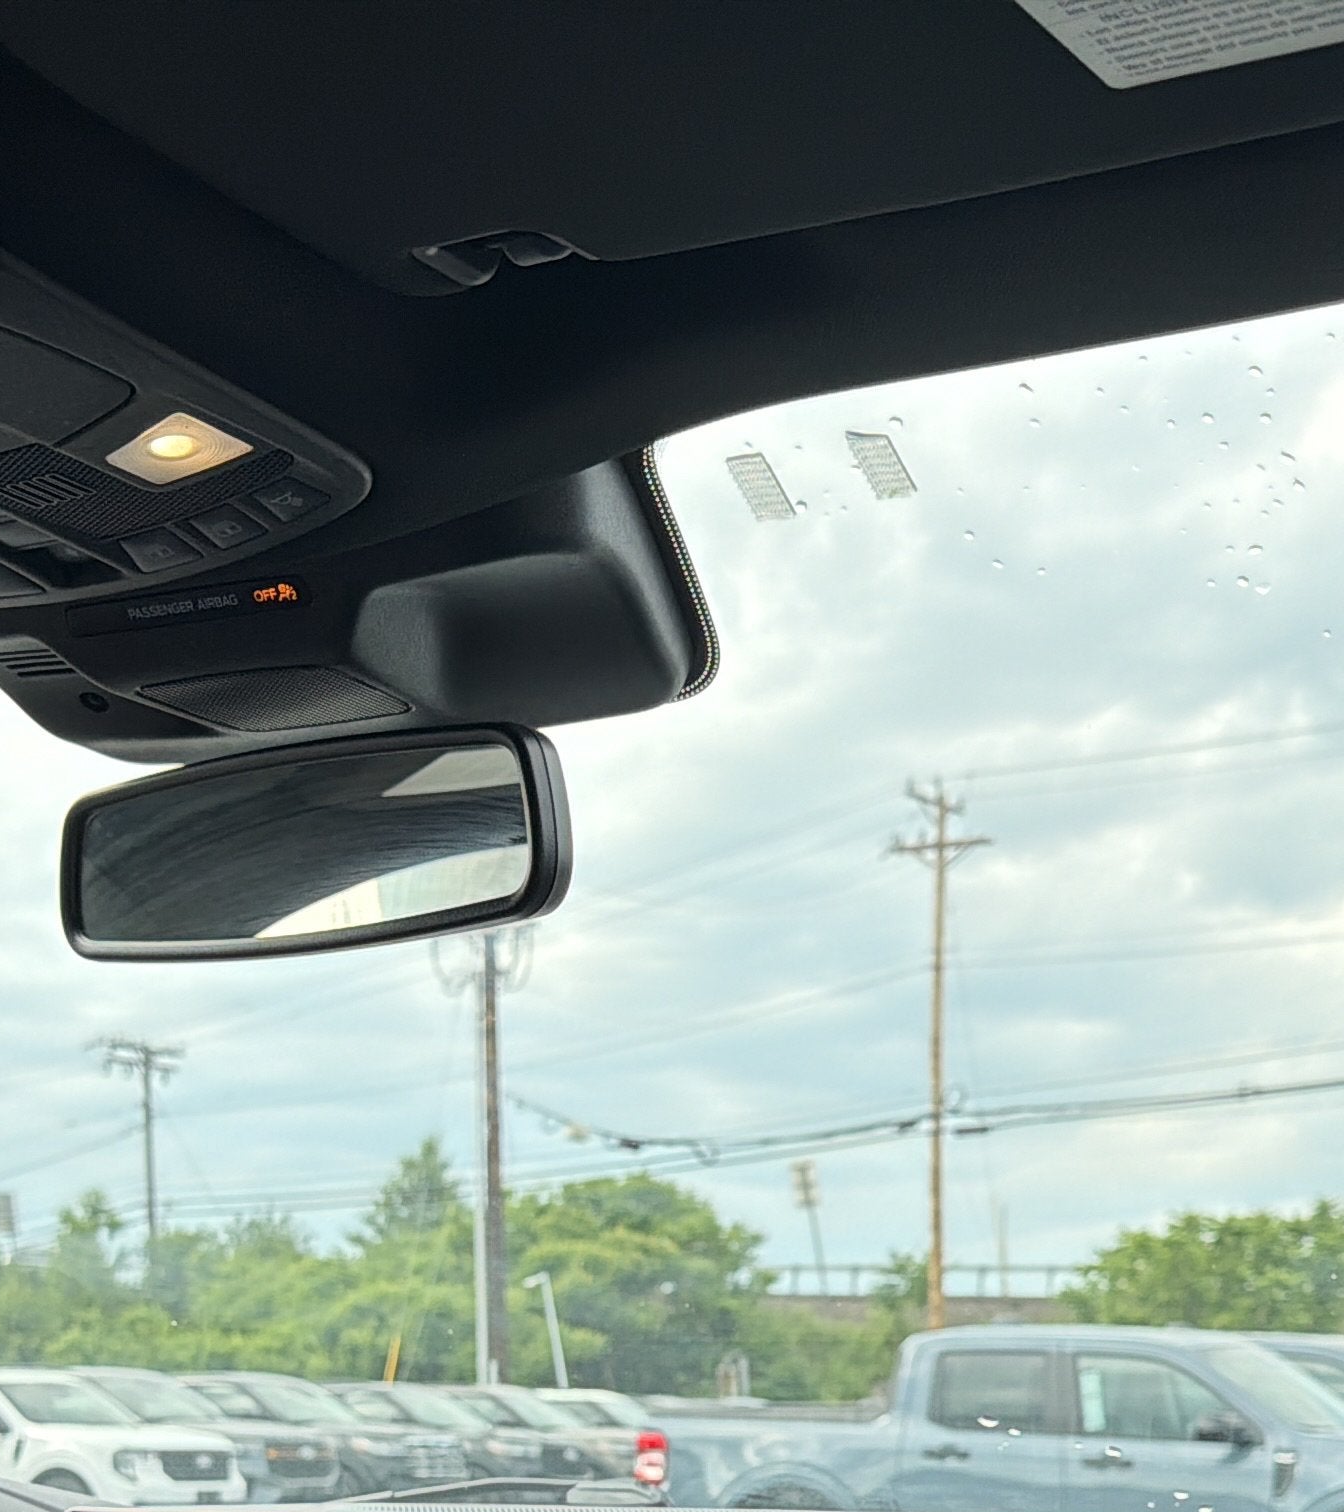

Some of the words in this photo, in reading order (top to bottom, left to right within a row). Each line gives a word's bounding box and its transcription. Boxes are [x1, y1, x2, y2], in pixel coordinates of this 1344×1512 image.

[127, 601, 194, 620] PASSENGER
[197, 594, 239, 611] AIRBAG
[253, 587, 278, 602] OFF
